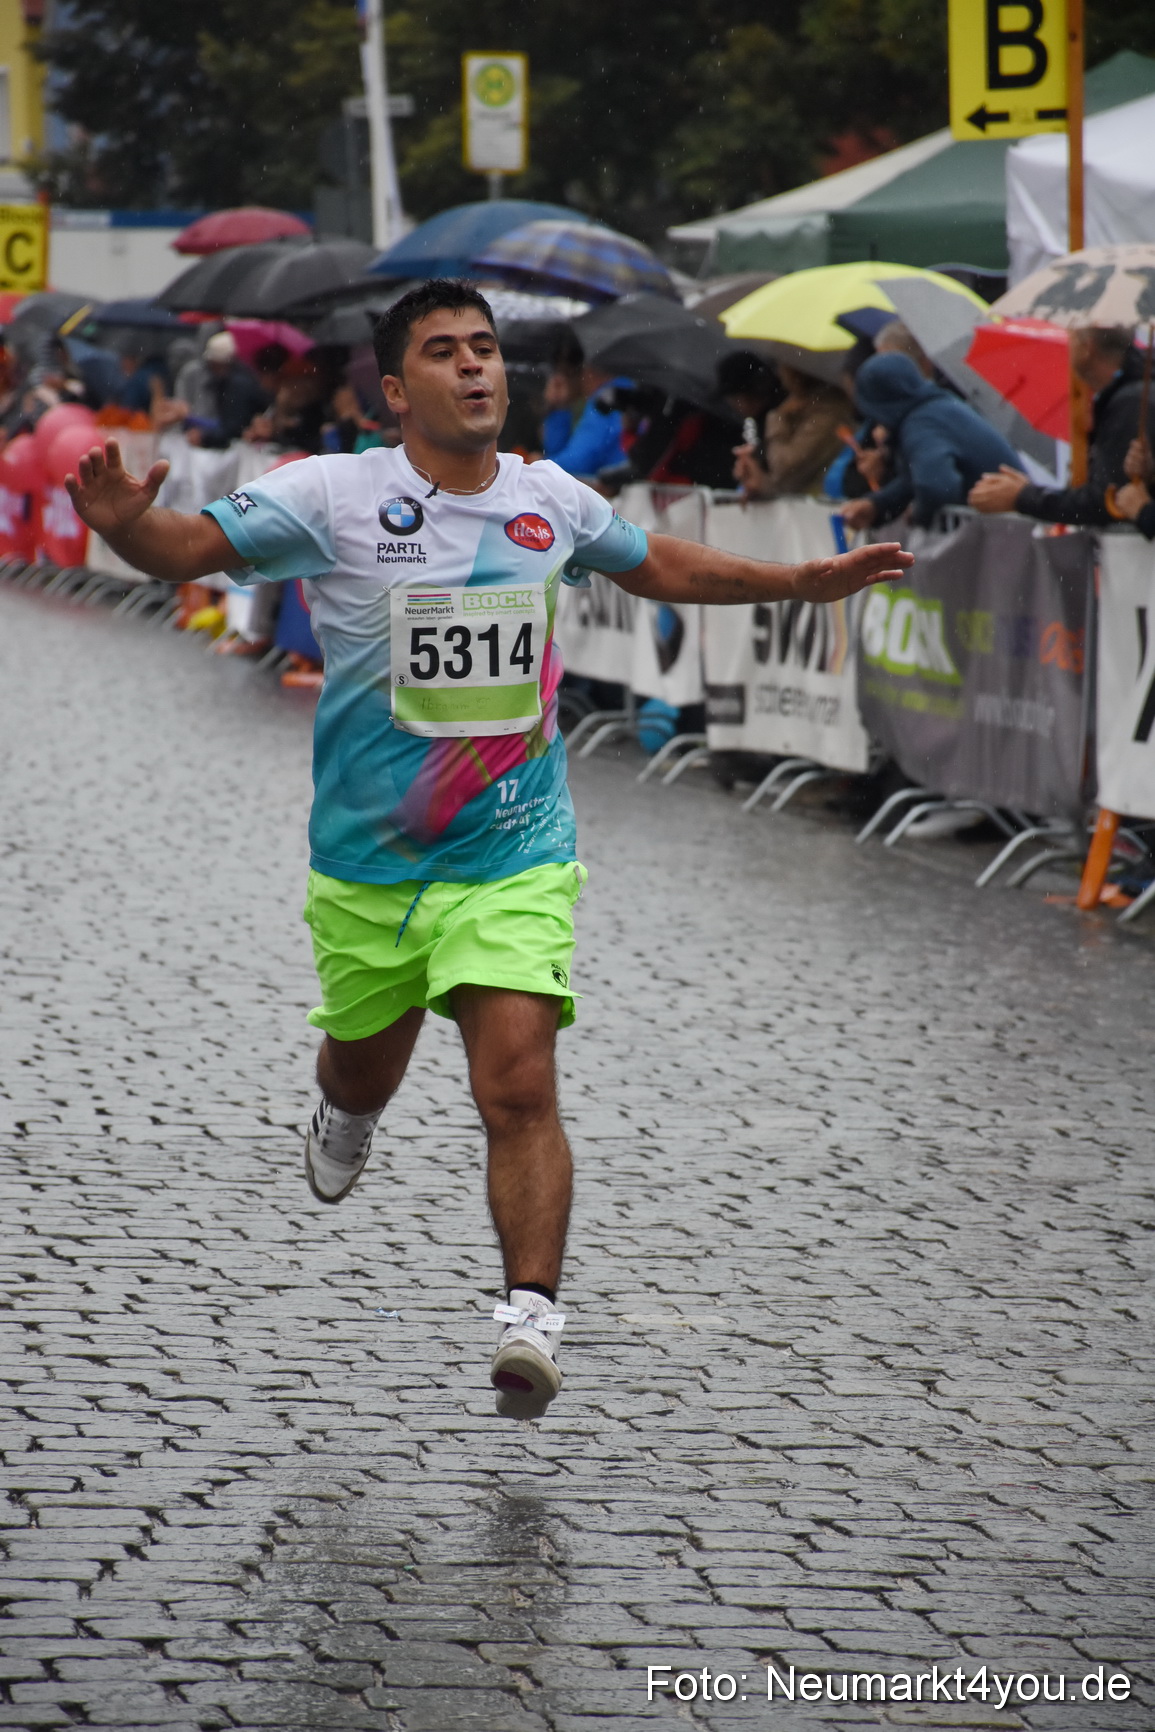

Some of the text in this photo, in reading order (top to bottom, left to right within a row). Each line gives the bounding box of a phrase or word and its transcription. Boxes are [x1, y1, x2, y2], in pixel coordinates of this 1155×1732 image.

[986, 0, 1048, 91] B
[5, 230, 34, 275] C
[382, 498, 420, 509] BMW
[377, 542, 427, 555] PARTL
[377, 554, 427, 564] Neumarkt
[462, 590, 535, 611] BOCK
[405, 605, 454, 615] NeuerMarkt
[463, 610, 485, 618] inspired
[513, 608, 536, 616] concepts
[410, 622, 534, 681] 5314
[398, 675, 405, 685] S
